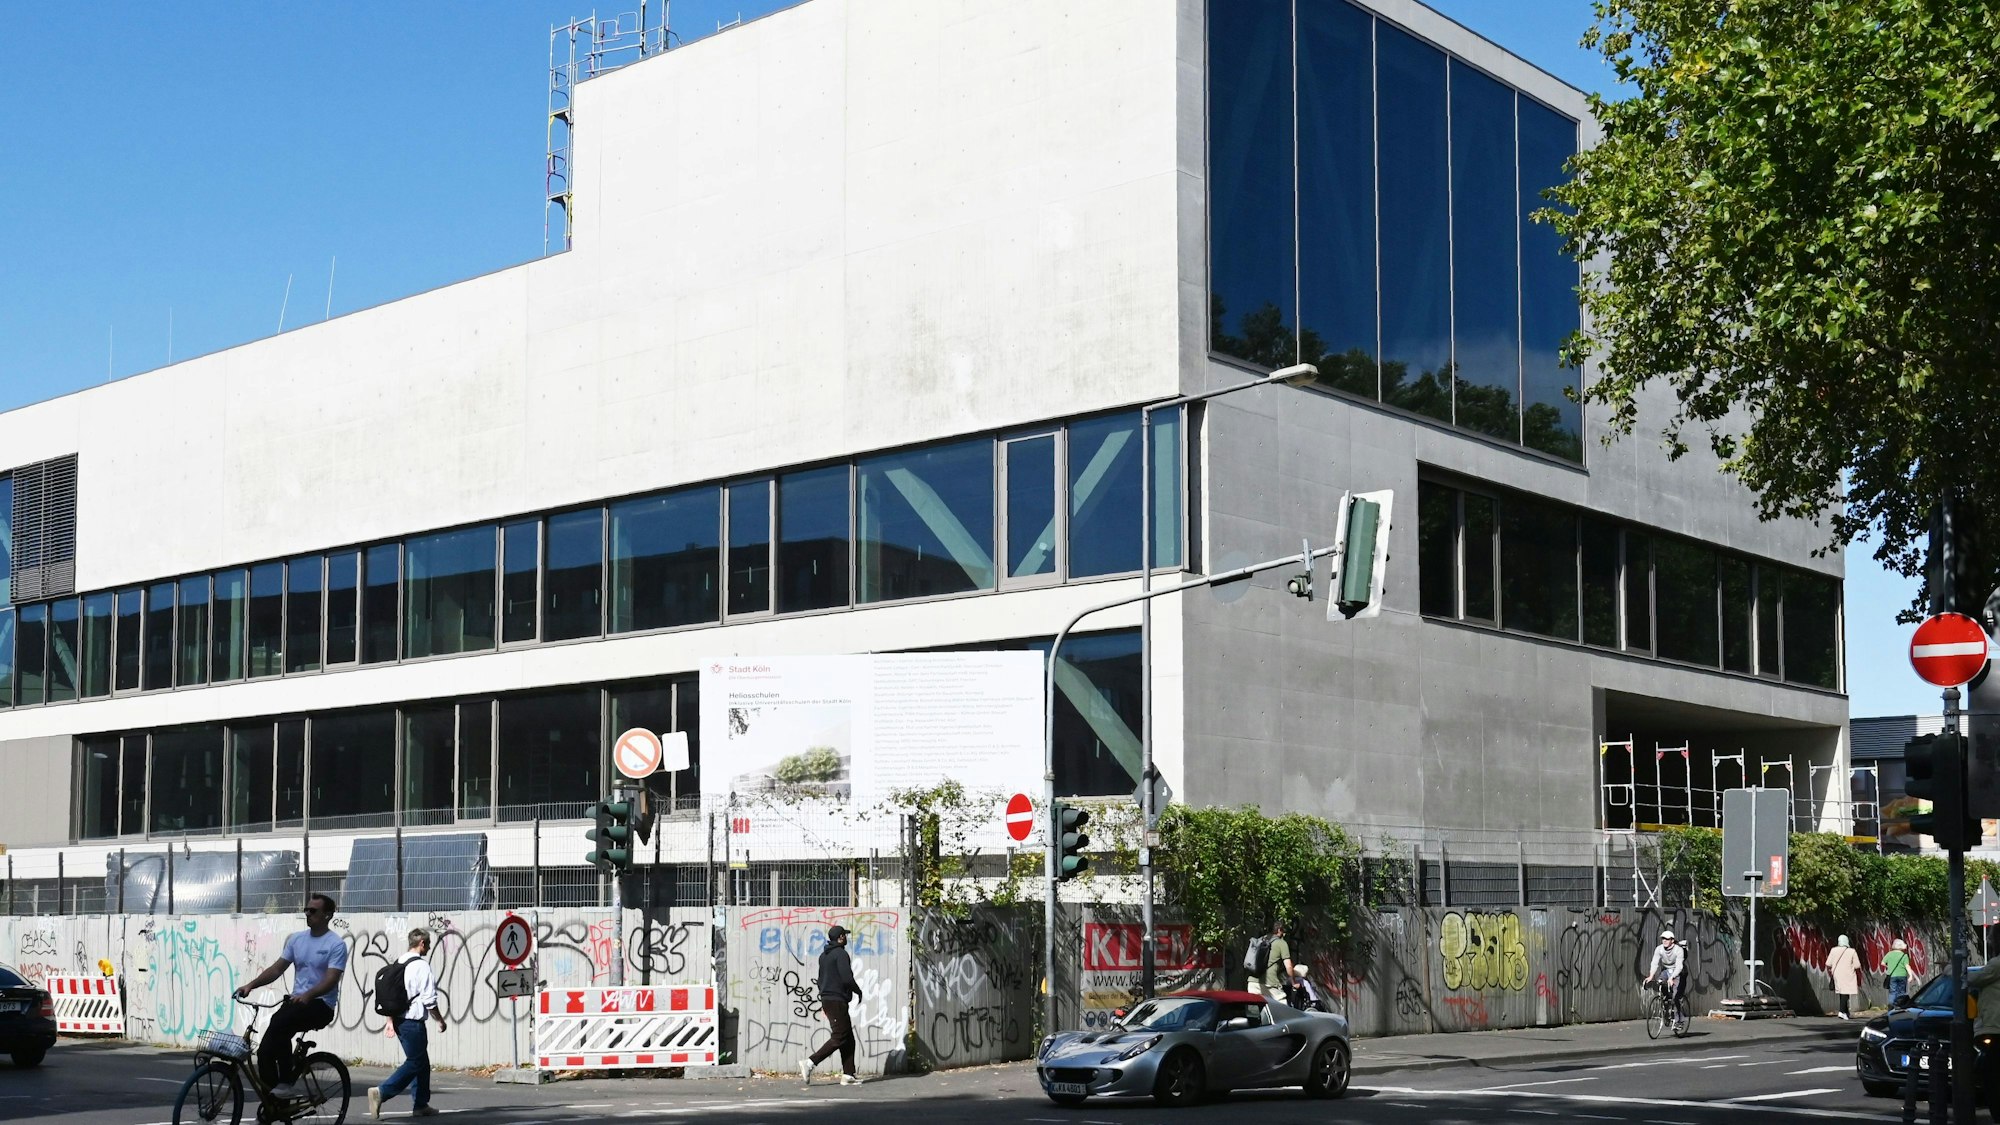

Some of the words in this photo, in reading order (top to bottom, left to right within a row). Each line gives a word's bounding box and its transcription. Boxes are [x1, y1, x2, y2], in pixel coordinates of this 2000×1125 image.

[728, 665, 751, 673] Stadt
[752, 664, 771, 673] Köln
[728, 691, 780, 699] Heliosschulen
